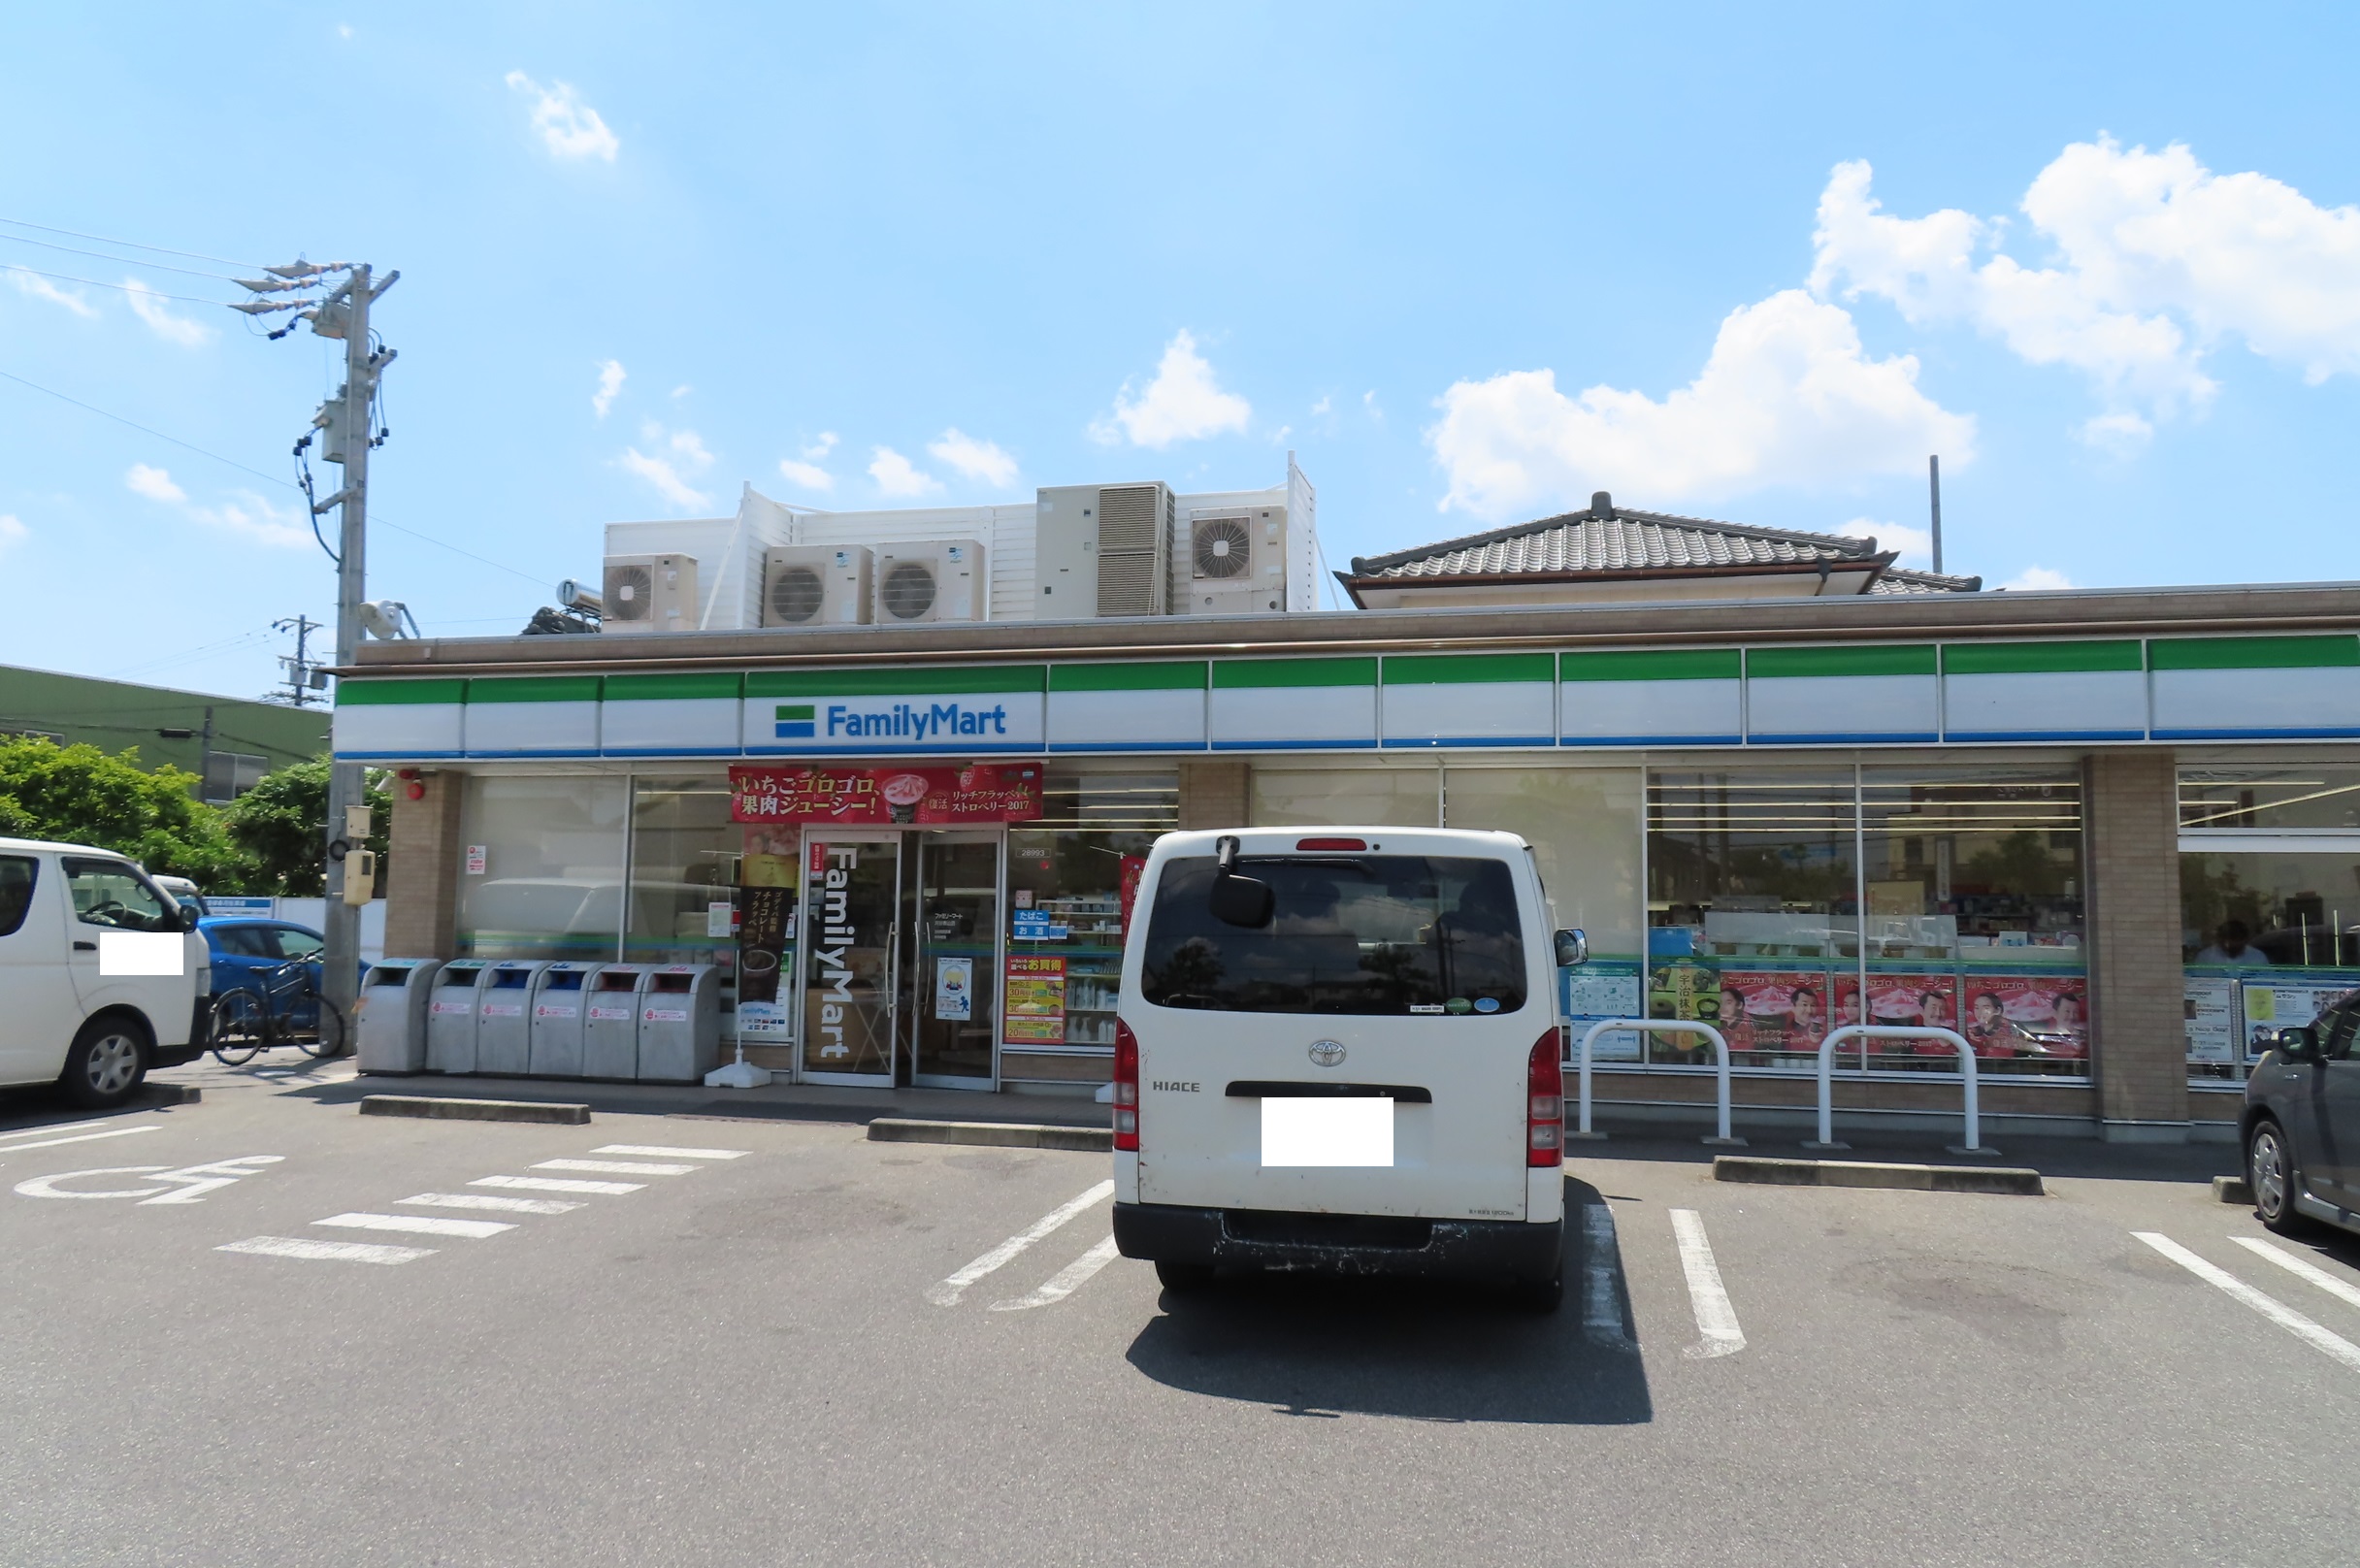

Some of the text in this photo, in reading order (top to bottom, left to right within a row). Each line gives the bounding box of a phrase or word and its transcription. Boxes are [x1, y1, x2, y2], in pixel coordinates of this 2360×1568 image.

[828, 703, 1006, 741] FamilyMart
[740, 773, 880, 796] いちごゴロゴロ、
[741, 795, 875, 816] 果肉ジューシー!
[928, 798, 948, 810] 復活
[758, 891, 771, 944] チョコレート
[1019, 911, 1044, 921] たばこ
[814, 847, 858, 1059] FamilyMart
[1153, 1081, 1200, 1093] HIACE
